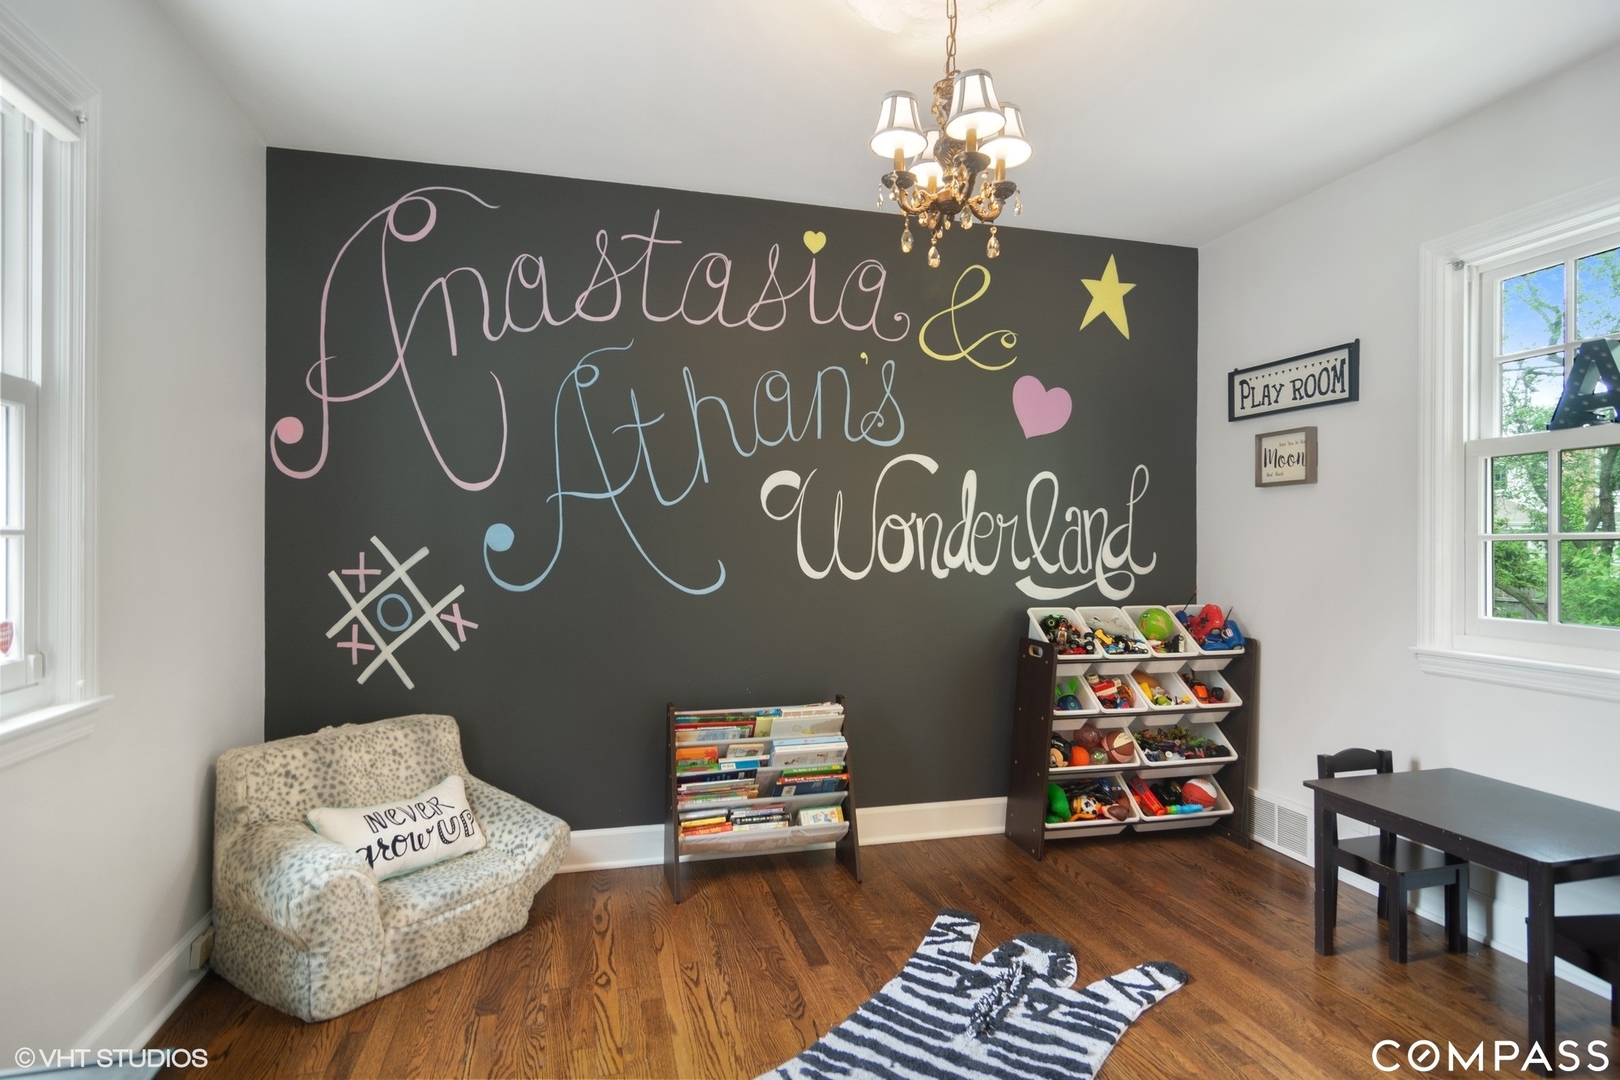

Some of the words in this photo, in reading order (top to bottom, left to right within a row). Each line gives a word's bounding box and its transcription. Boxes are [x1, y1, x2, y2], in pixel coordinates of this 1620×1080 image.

[270, 186, 910, 491] Anastasia
[918, 264, 1018, 371] &
[1239, 379, 1285, 410] PLAY
[1289, 357, 1347, 401] ROOM
[484, 338, 905, 596] Athan's
[1263, 447, 1306, 469] Moon
[760, 453, 1157, 601] Wonderland
[436, 809, 475, 845] UP
